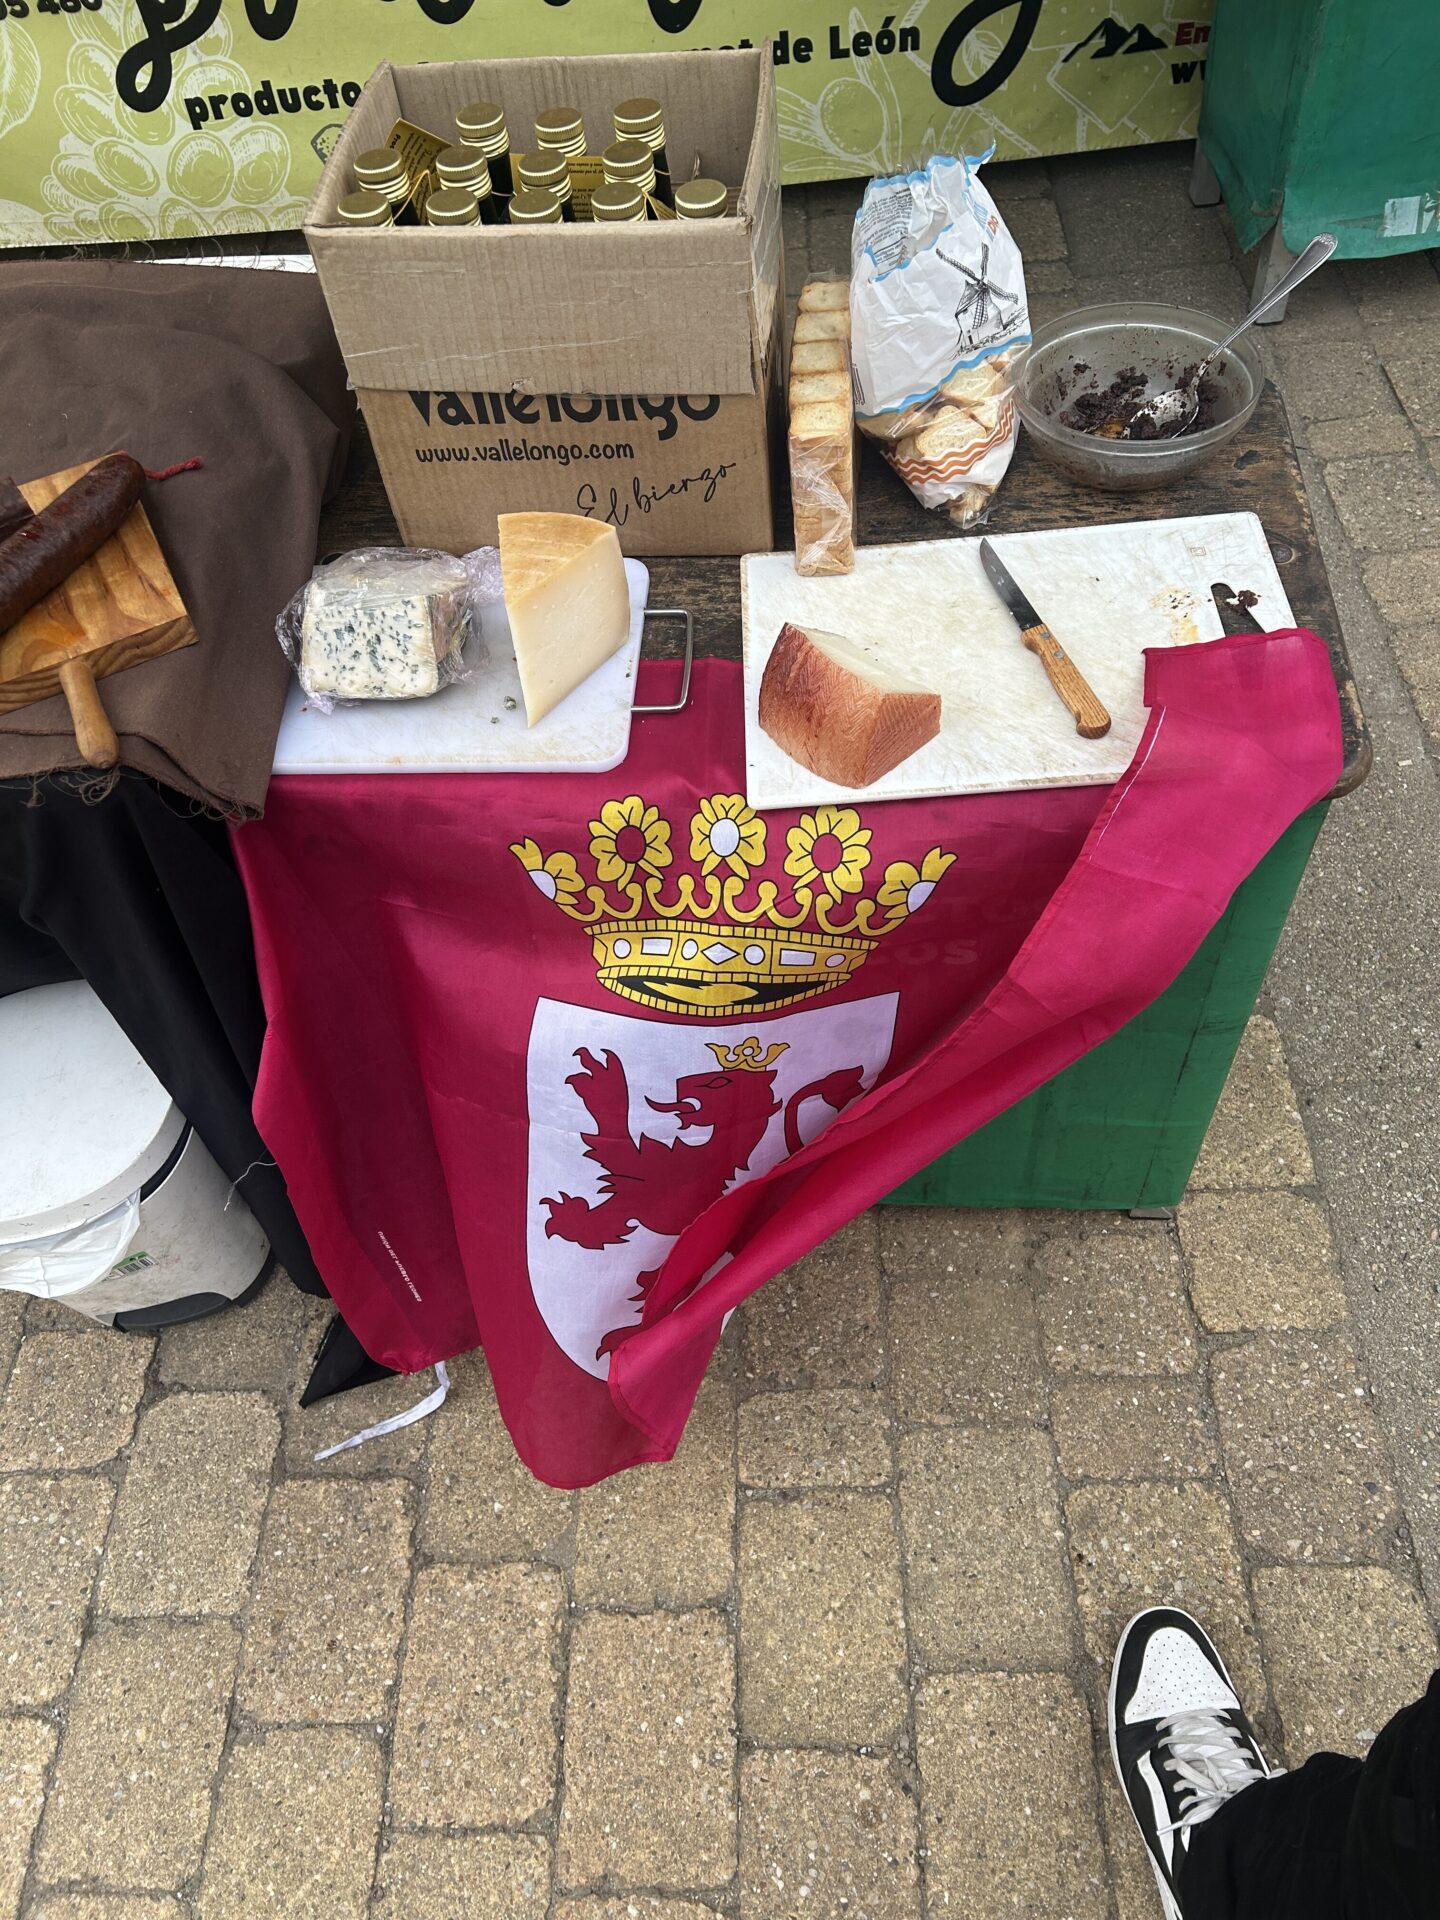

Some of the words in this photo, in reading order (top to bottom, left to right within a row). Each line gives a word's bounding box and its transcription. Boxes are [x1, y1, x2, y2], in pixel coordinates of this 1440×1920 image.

[184, 79, 368, 131] producto
[773, 30, 815, 66] de
[829, 16, 920, 59] León
[415, 438, 635, 466] www.vallelongo.com
[577, 483, 629, 526] El
